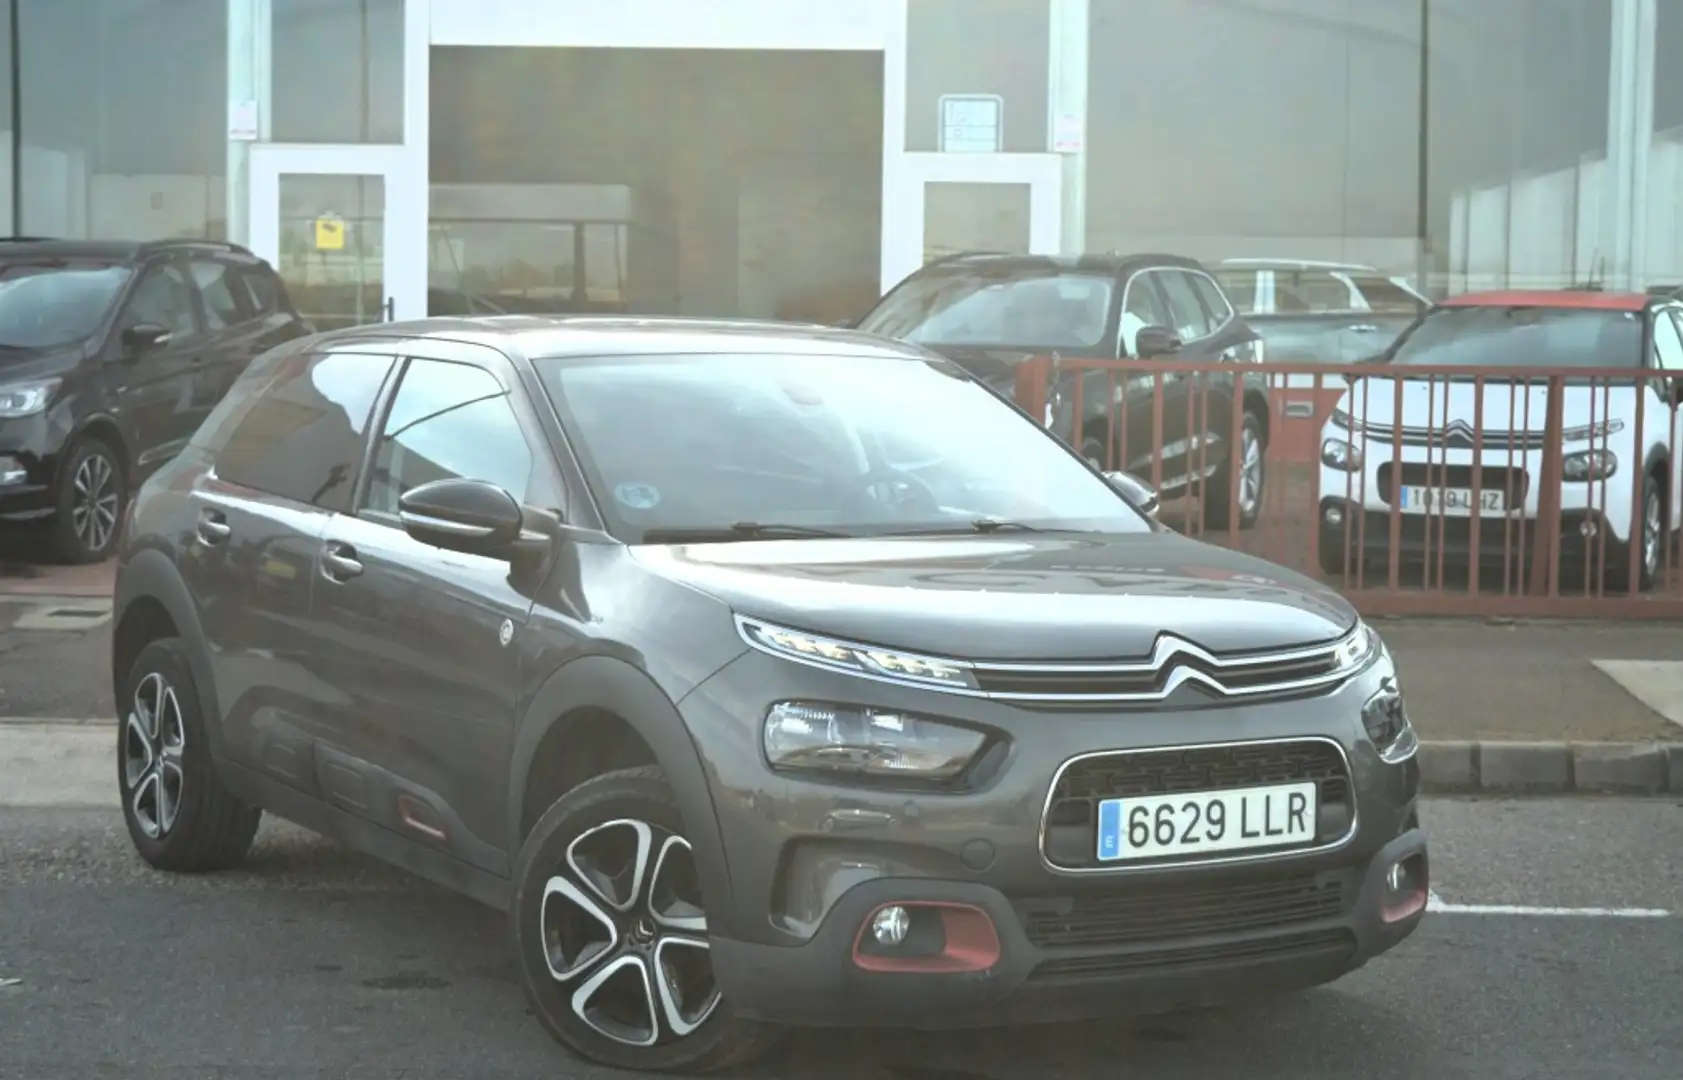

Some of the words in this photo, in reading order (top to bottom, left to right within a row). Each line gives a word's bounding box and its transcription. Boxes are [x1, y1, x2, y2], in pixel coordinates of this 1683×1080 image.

[1413, 488, 1457, 508] 109
[1128, 799, 1226, 848] 6629
[1241, 792, 1307, 839] LLR
[1106, 835, 1114, 849] E
